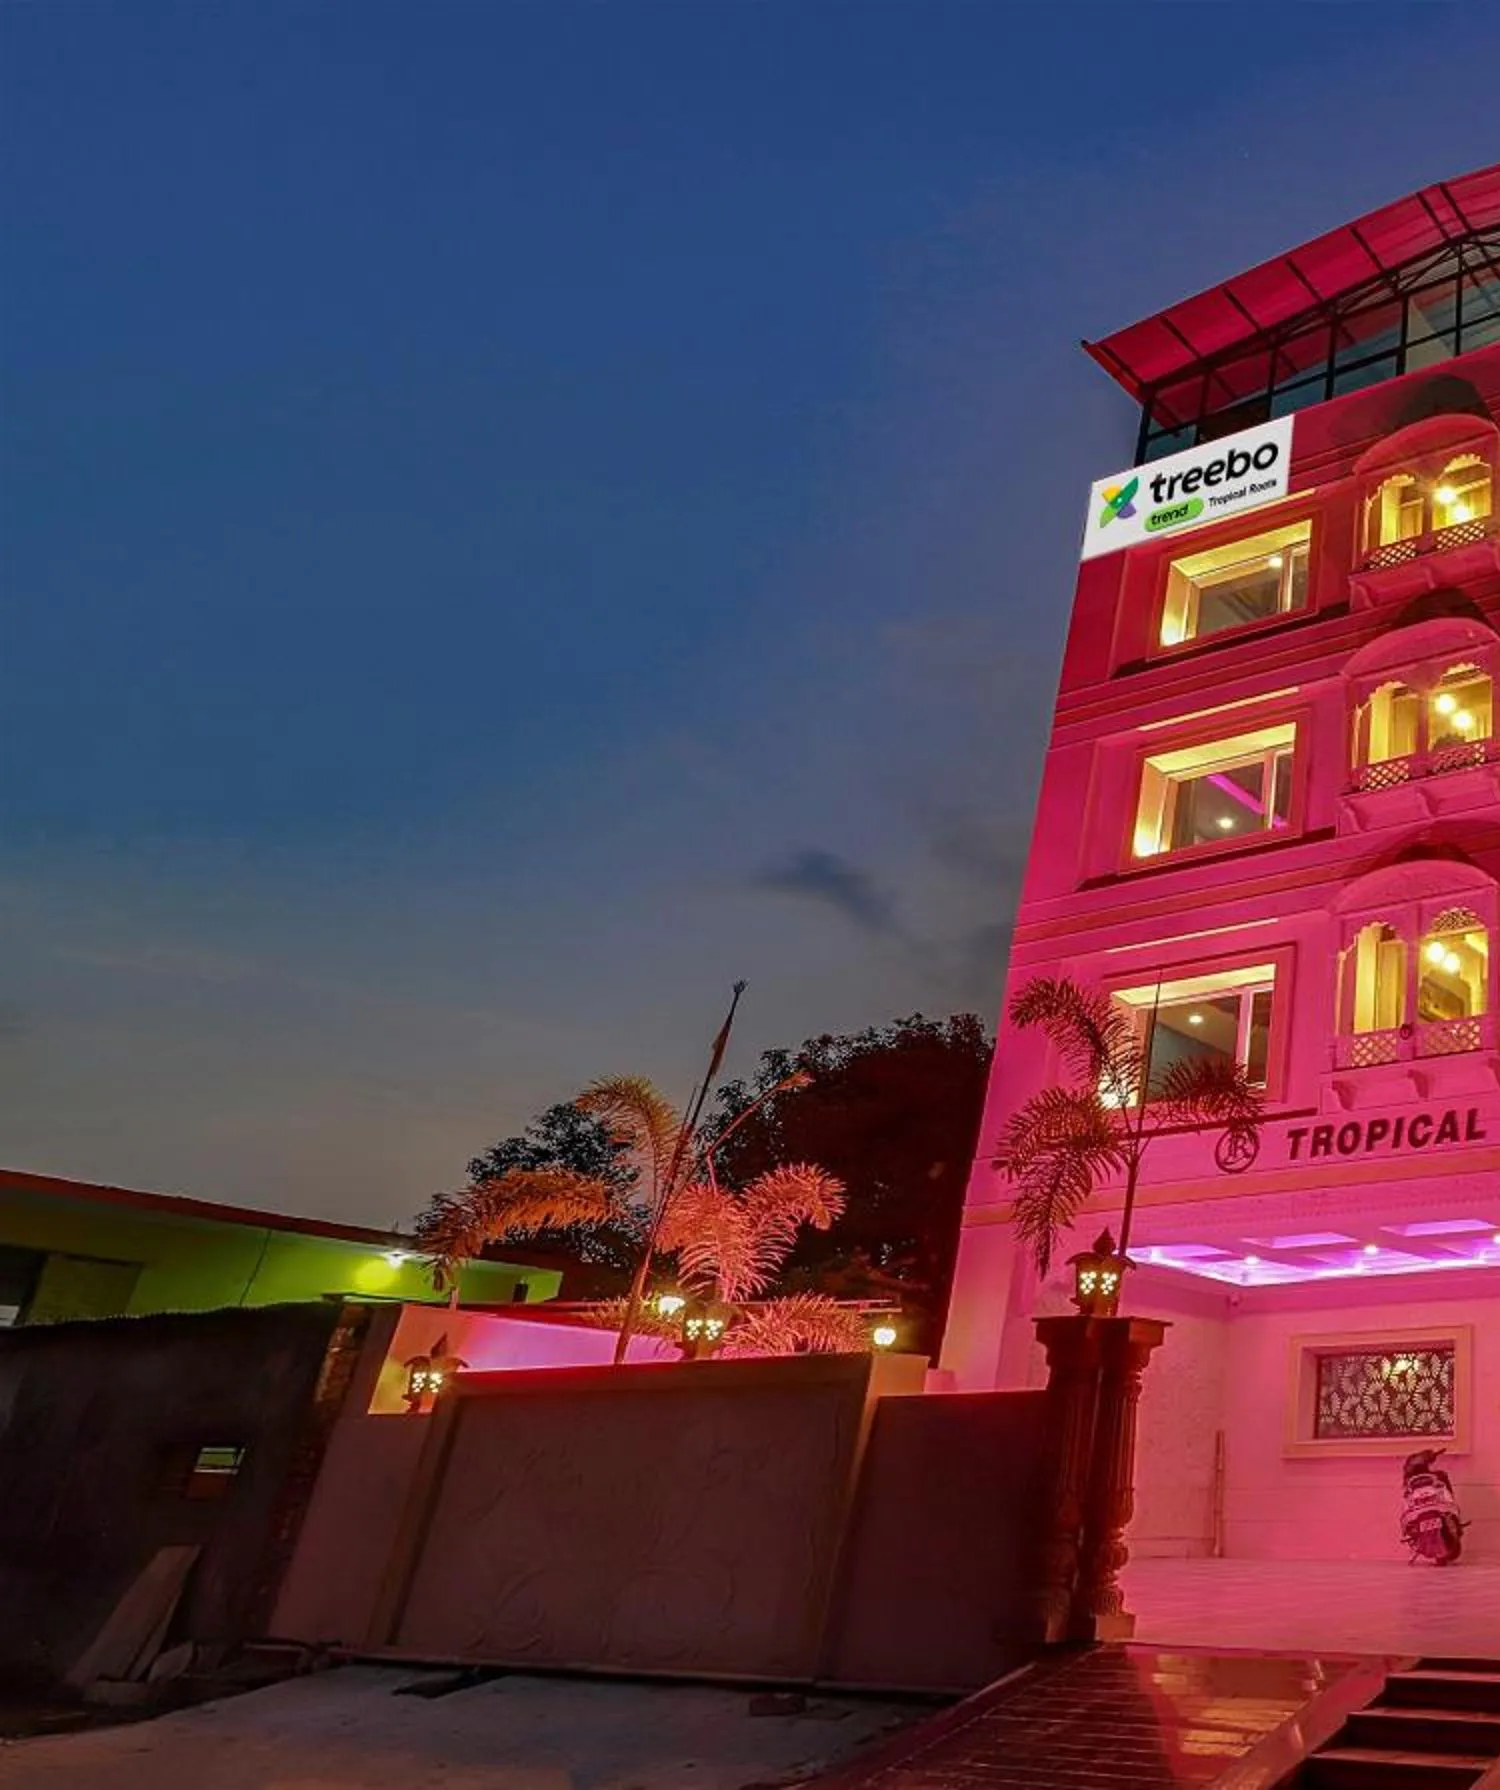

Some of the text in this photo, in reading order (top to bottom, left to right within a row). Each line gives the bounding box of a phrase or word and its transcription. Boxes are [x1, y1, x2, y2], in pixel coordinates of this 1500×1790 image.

[1149, 441, 1279, 503] treebo
[1151, 504, 1188, 526] trend
[1208, 486, 1246, 507] Tropical
[1287, 1107, 1486, 1160] TROPICAL
